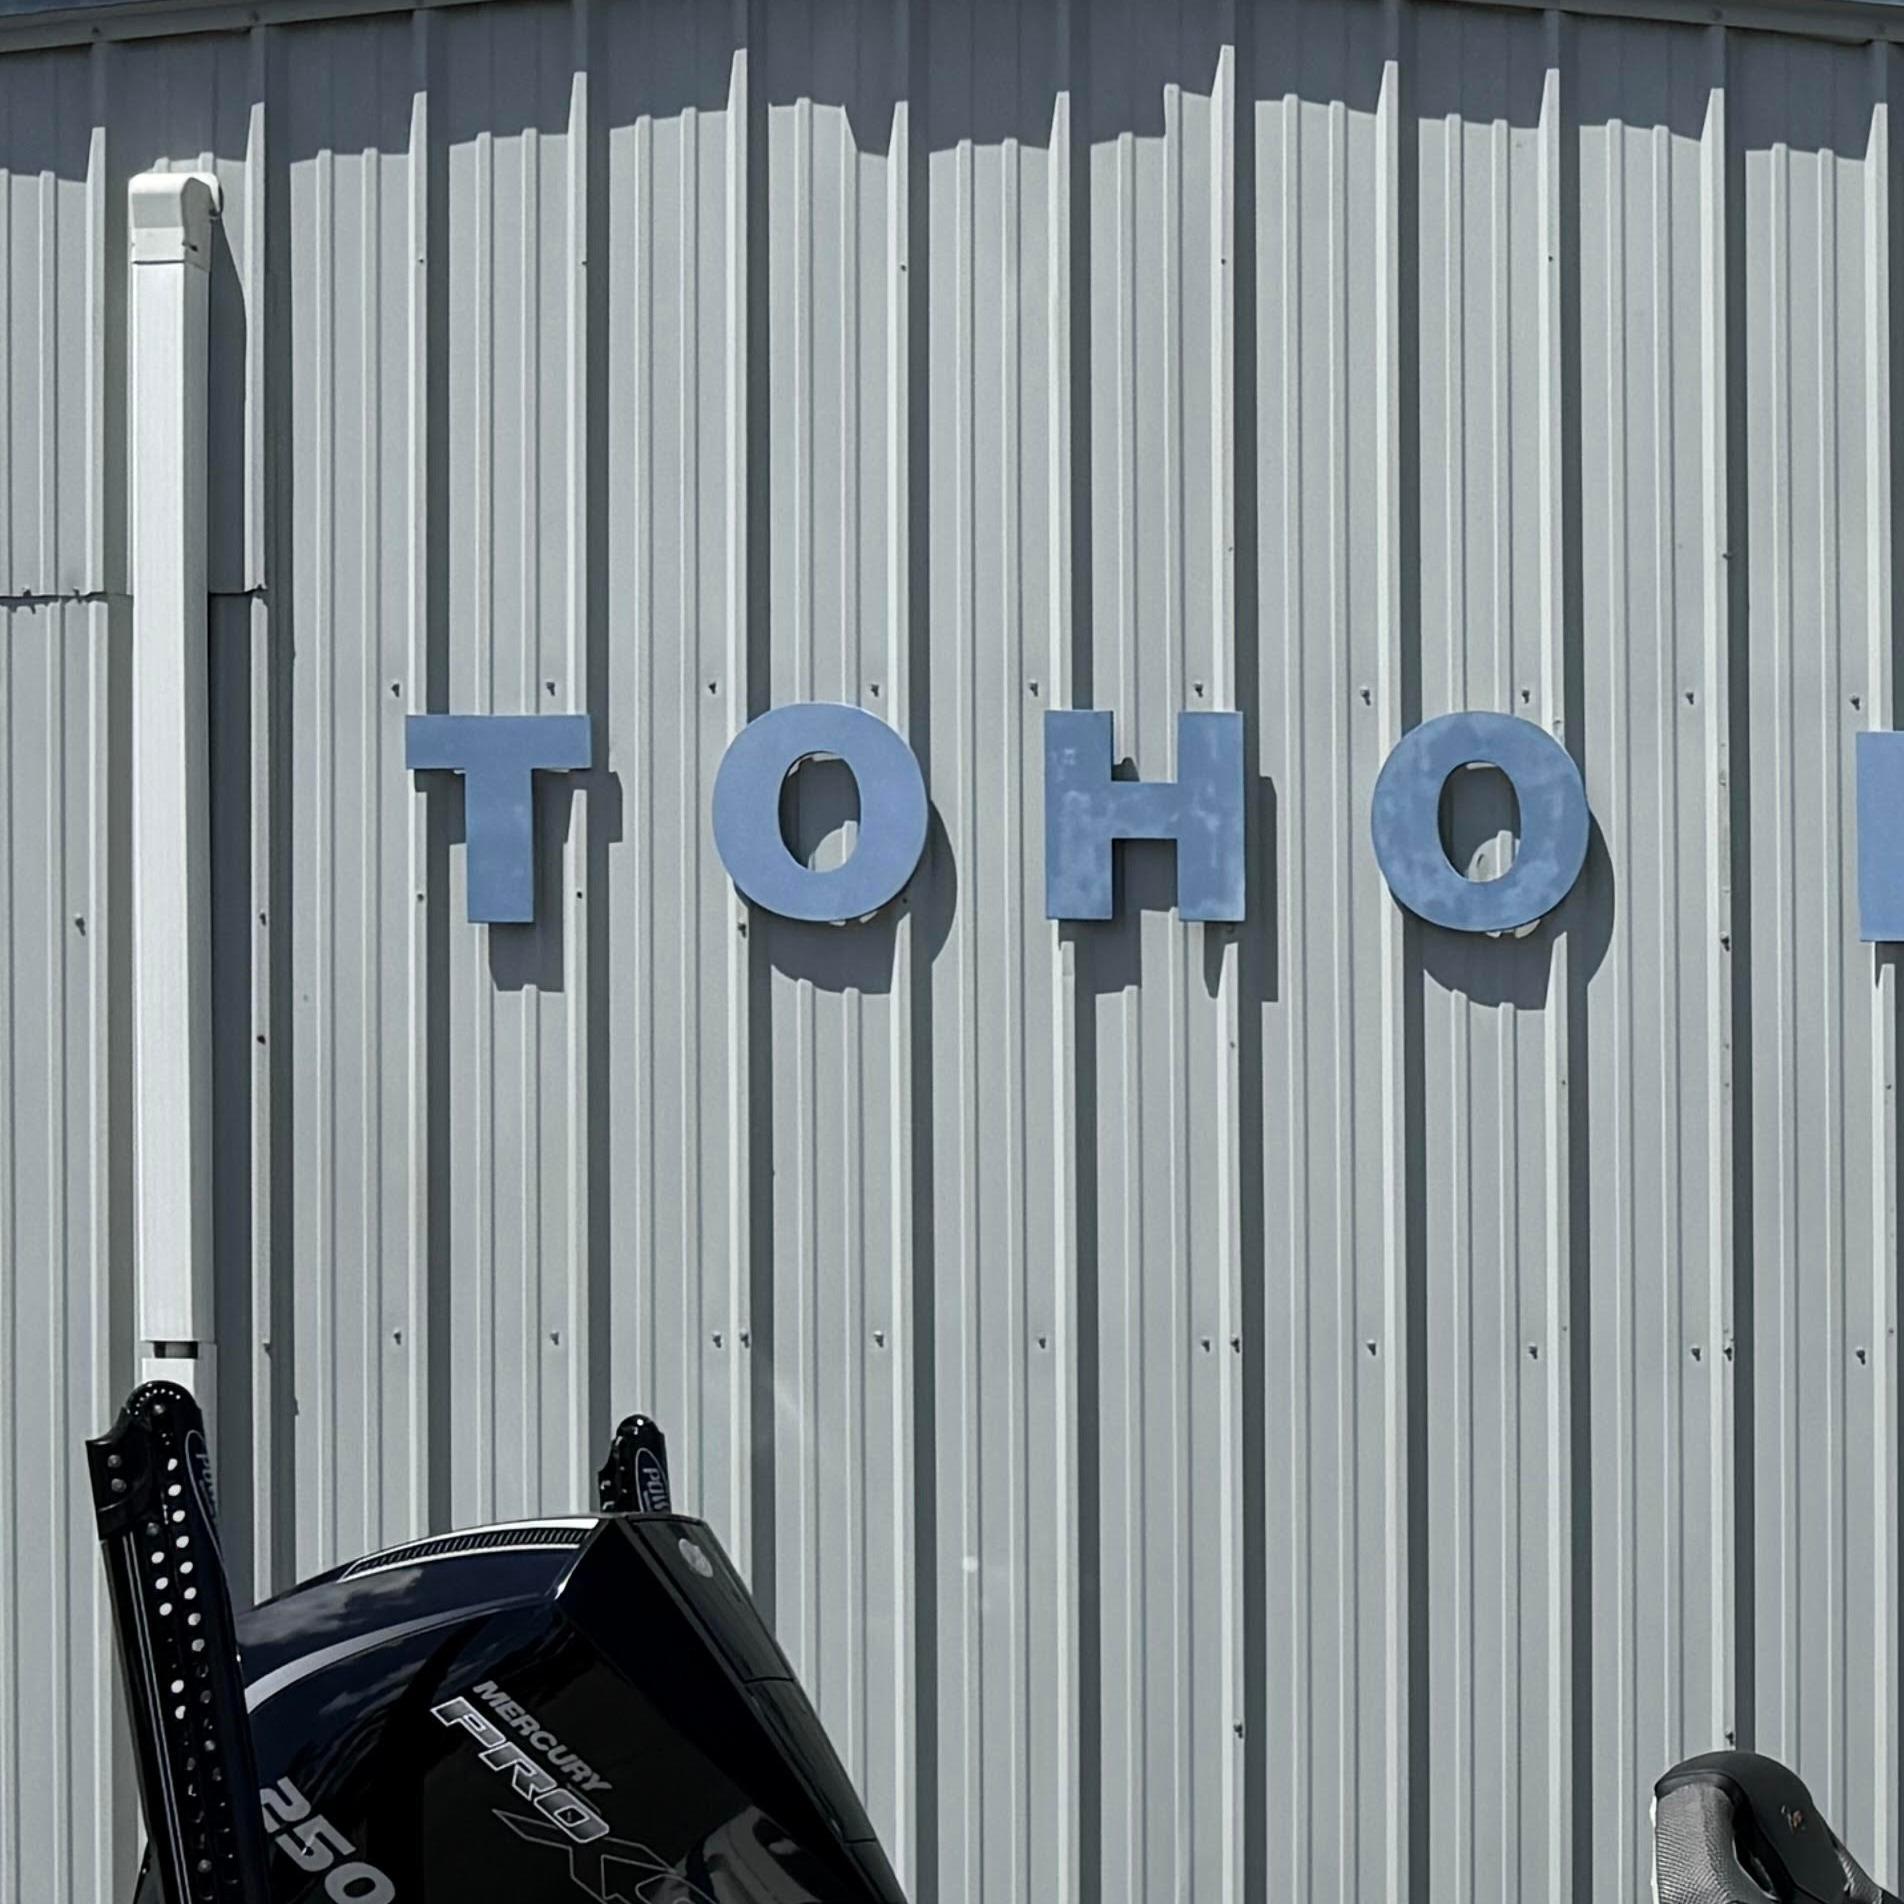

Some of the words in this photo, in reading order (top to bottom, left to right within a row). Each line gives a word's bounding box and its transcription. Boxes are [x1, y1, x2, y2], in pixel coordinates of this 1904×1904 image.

[405, 702, 1591, 933] TOHO
[430, 1696, 609, 1843] PRO
[473, 1680, 612, 1791] MERCURY
